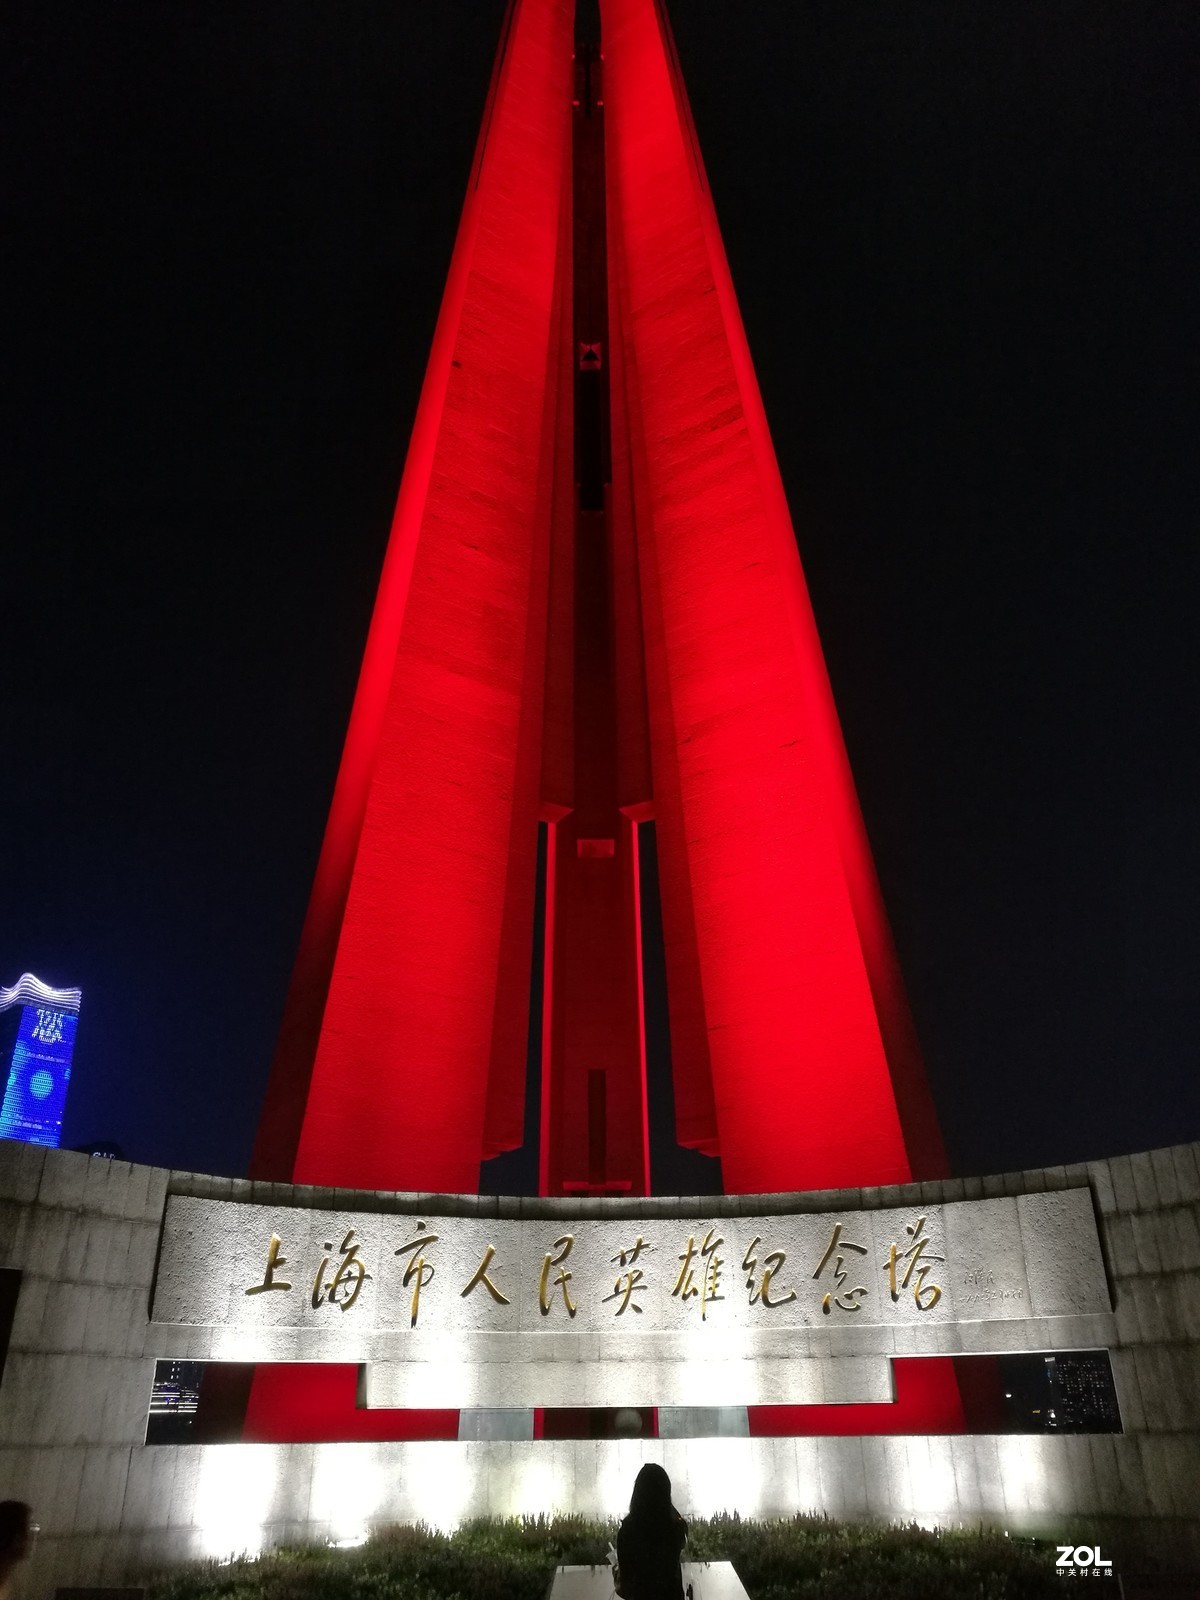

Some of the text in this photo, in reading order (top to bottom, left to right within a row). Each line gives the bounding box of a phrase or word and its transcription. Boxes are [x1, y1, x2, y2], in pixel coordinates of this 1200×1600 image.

[245, 1216, 945, 1328] 上海市人民英雄纪念塔
